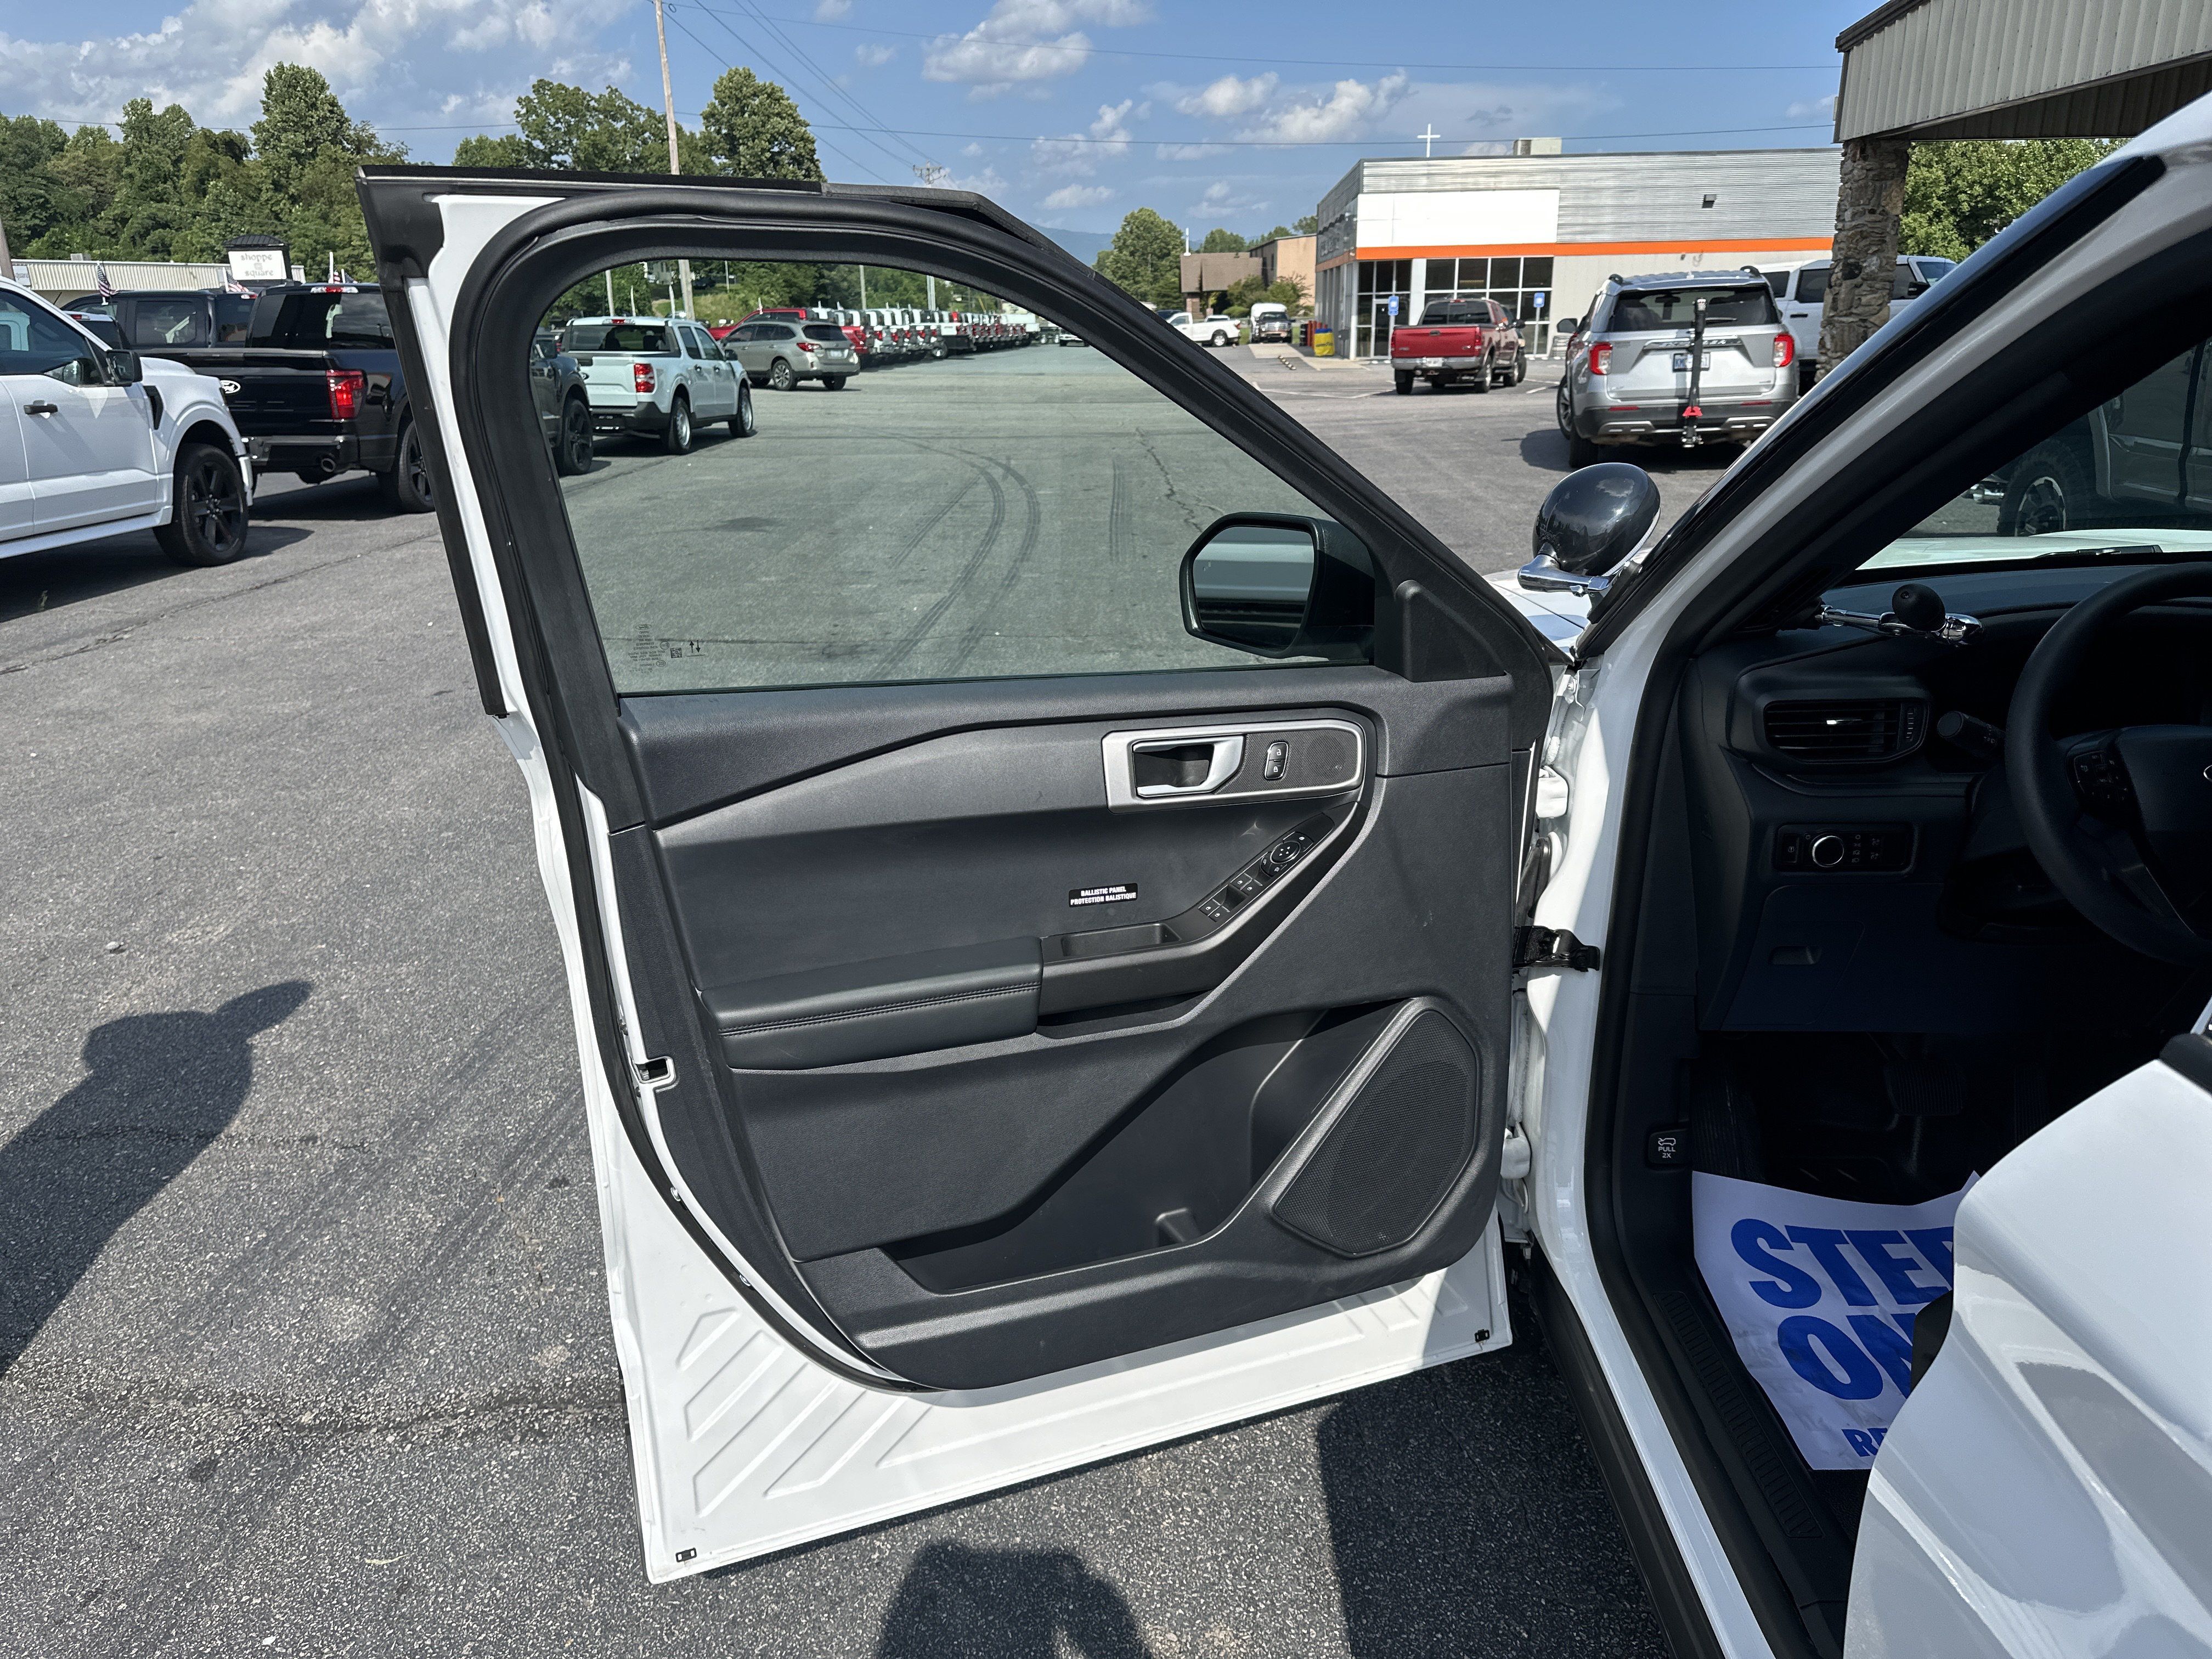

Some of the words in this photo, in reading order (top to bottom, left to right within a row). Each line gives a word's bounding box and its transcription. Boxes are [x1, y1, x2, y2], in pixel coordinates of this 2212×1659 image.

[241, 253, 273, 262] shoppe
[245, 269, 273, 278] square
[1081, 888, 1108, 896] BALLISTIC
[1070, 896, 1104, 905] PROTECTION
[1105, 892, 1136, 901] BALISTIQUE
